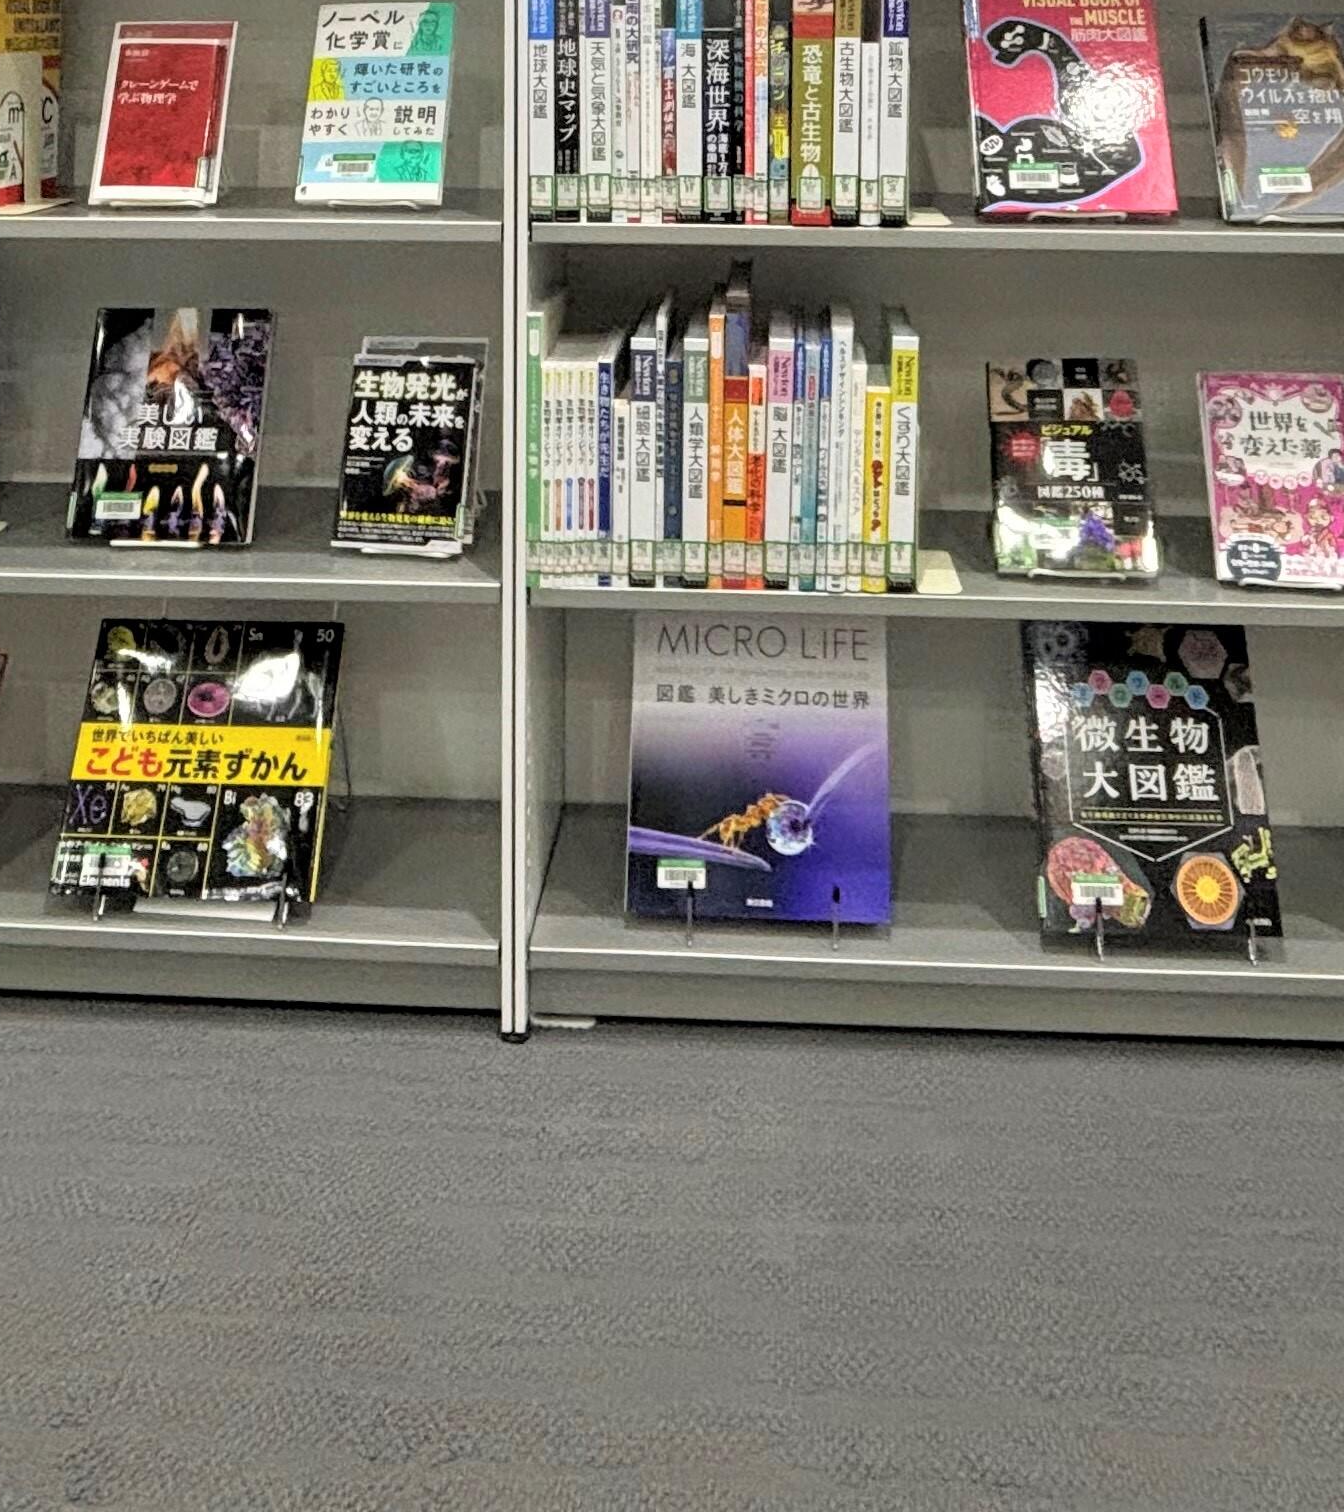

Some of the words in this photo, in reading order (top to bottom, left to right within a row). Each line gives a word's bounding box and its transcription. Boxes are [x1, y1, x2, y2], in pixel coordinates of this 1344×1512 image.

[322, 9, 404, 27] ノーベル
[1084, 9, 1146, 25] MUSCLE
[325, 30, 403, 51] 化学賞に
[353, 63, 443, 76] 輝いた研究の
[533, 44, 548, 119] 地球大図鑑
[888, 41, 903, 118] 鉱物大図鑑
[1240, 68, 1300, 84] コウモリは
[120, 79, 199, 91] クレーンゲームで
[350, 81, 440, 94] すごいところを
[557, 38, 577, 142] 地球史マップ
[706, 39, 729, 133] 深海世界
[839, 41, 854, 133] 古生物大図鑑
[118, 93, 176, 105] 学ぶ物理学
[590, 41, 606, 161] 天気と気象大図鑑
[801, 44, 822, 163] 恐竜と古生物
[310, 108, 350, 119] わかり
[394, 105, 436, 125] 説明
[308, 124, 347, 136] やすく
[393, 126, 435, 136] してみた
[354, 370, 469, 402] 生物発光が
[352, 400, 465, 429] 人類の未来を
[1249, 411, 1307, 433] 世界を
[118, 427, 219, 451] 実験図鑑
[349, 426, 413, 452] 変える
[1041, 424, 1093, 435] ビジュアル
[636, 405, 651, 482] 細胞大図鑑
[688, 406, 703, 499] 人類学大図鑑
[727, 409, 745, 494] 人体大図鑑
[895, 406, 910, 496] くすり大図鑑
[1240, 437, 1322, 459] 変えた薬
[1037, 486, 1105, 499] 図鑑250種
[316, 628, 335, 643] 50
[657, 624, 787, 658] MICRO
[802, 628, 868, 661] LIFE
[656, 684, 695, 703] 図鑑
[708, 687, 870, 709] 美しきミクロの世界
[92, 728, 224, 745] 世界でいちばん美しい
[1073, 716, 1209, 754] 微生物
[86, 747, 308, 781] こども元素ずかん
[1083, 760, 1220, 802] 大図鑑
[68, 784, 107, 825] Xe
[224, 790, 237, 805] Bi
[294, 791, 314, 807] 83
